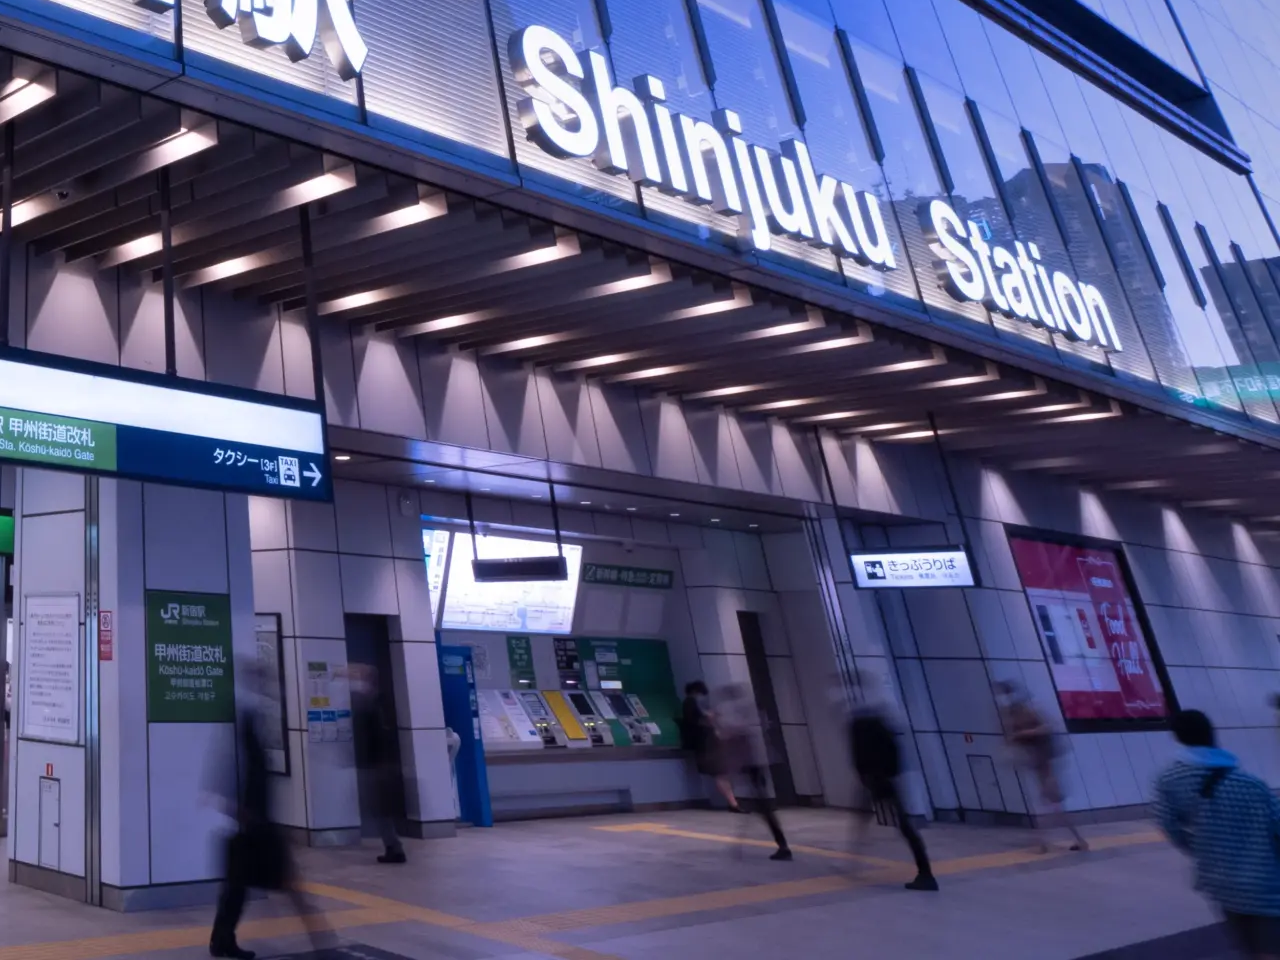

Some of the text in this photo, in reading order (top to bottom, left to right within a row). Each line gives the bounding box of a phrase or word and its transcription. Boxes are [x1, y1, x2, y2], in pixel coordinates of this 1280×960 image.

[519, 24, 1123, 352] Shinjuku Station
[9, 417, 96, 447] 甲州街道改札
[74, 448, 95, 461] Gate
[213, 447, 259, 466] タクシー
[280, 457, 297, 469] TAXI
[264, 473, 279, 485] Taxi
[160, 603, 180, 620] JR
[154, 643, 227, 663] 甲州街道改札
[206, 665, 224, 676] Gate
